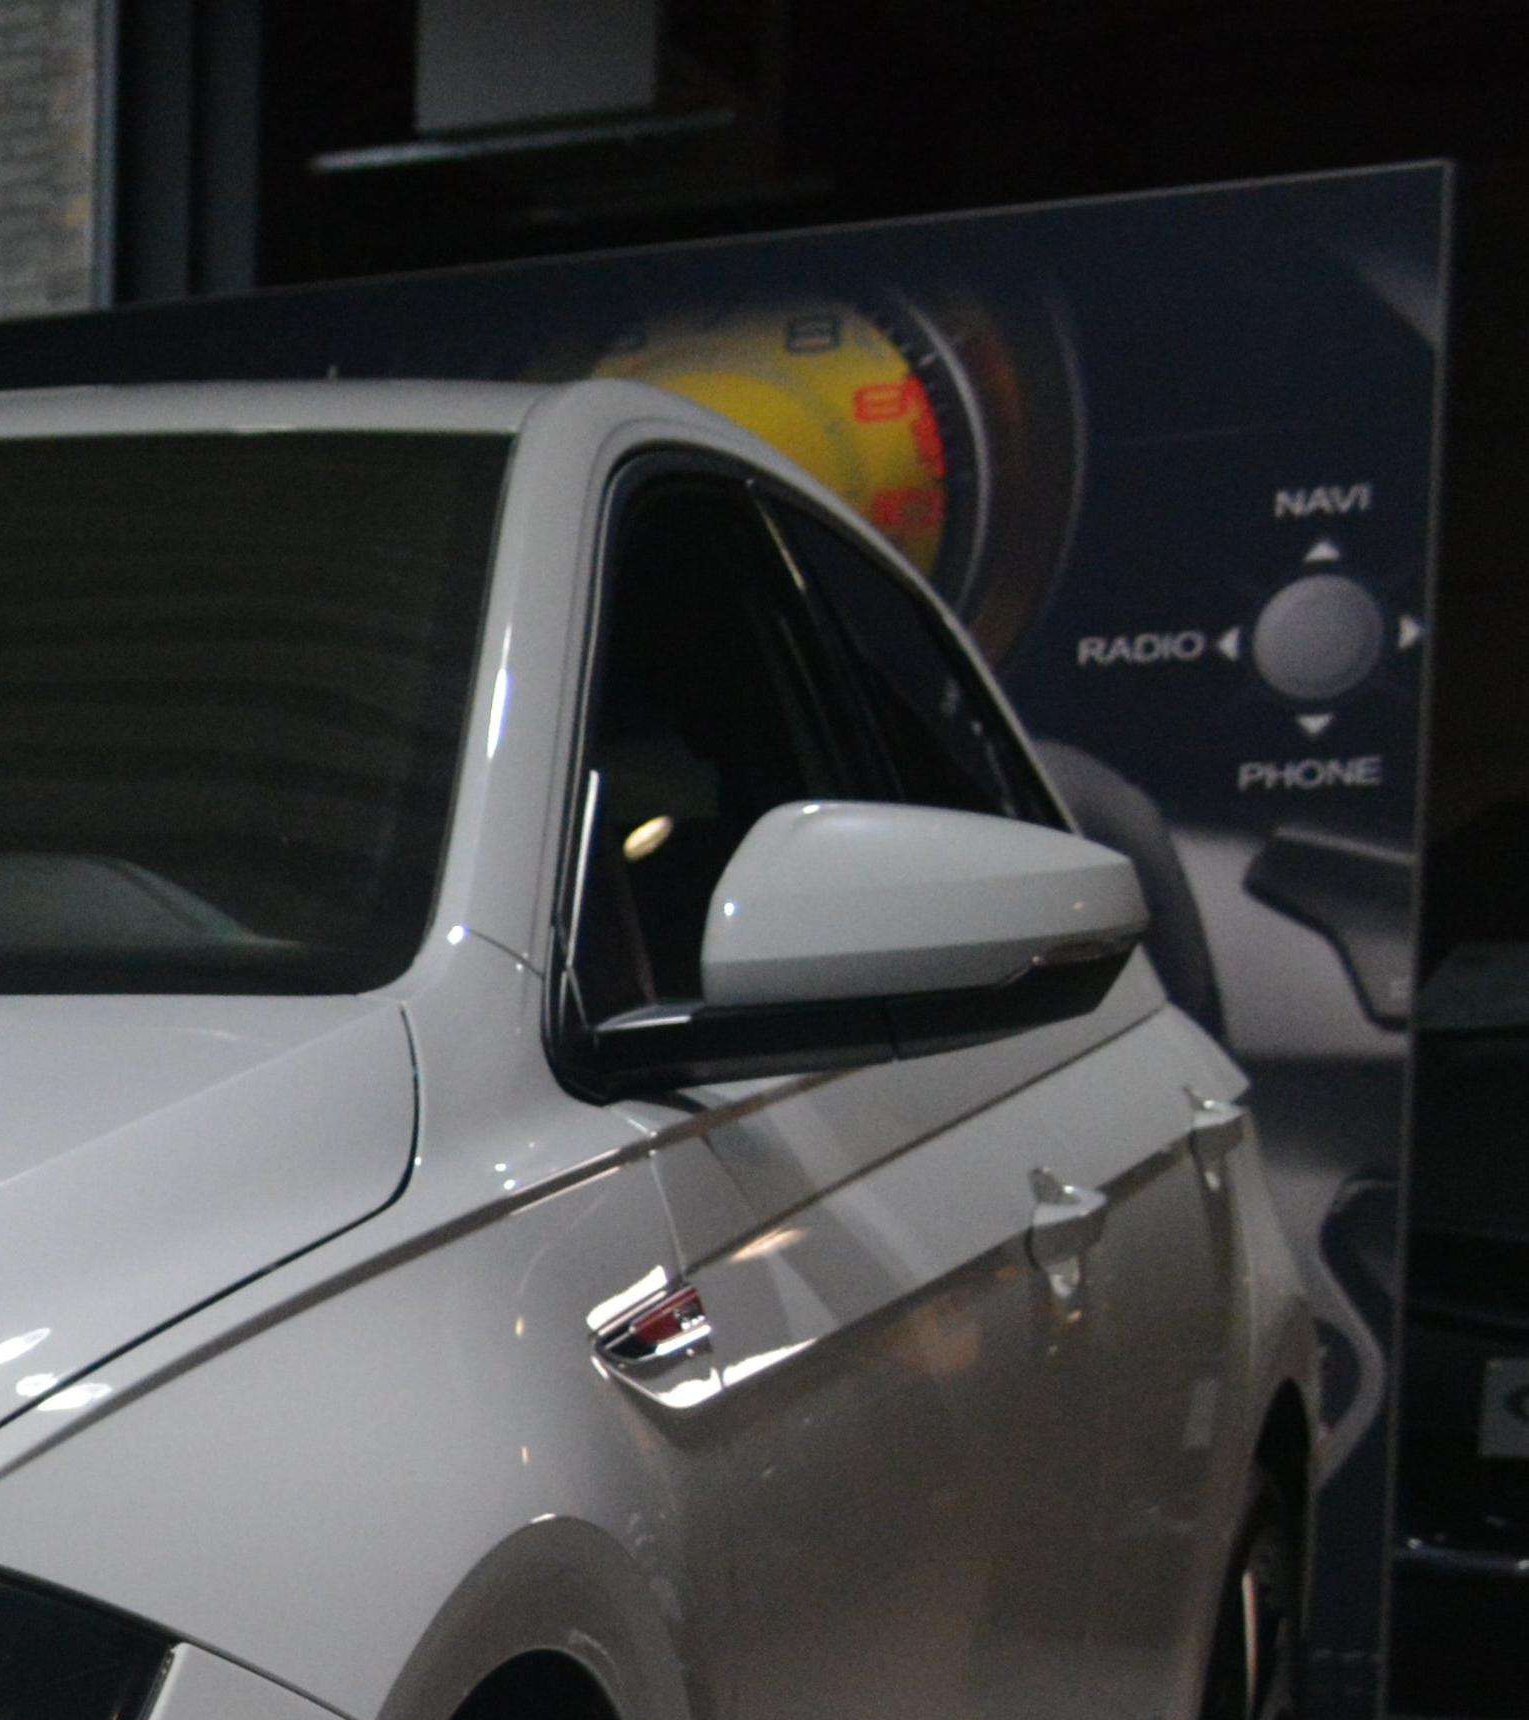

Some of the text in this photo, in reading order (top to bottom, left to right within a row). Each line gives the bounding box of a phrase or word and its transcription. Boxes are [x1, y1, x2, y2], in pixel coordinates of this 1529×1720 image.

[1273, 481, 1374, 520] NAVI
[1076, 629, 1207, 667] RADIO
[1237, 753, 1384, 792] PHONE
